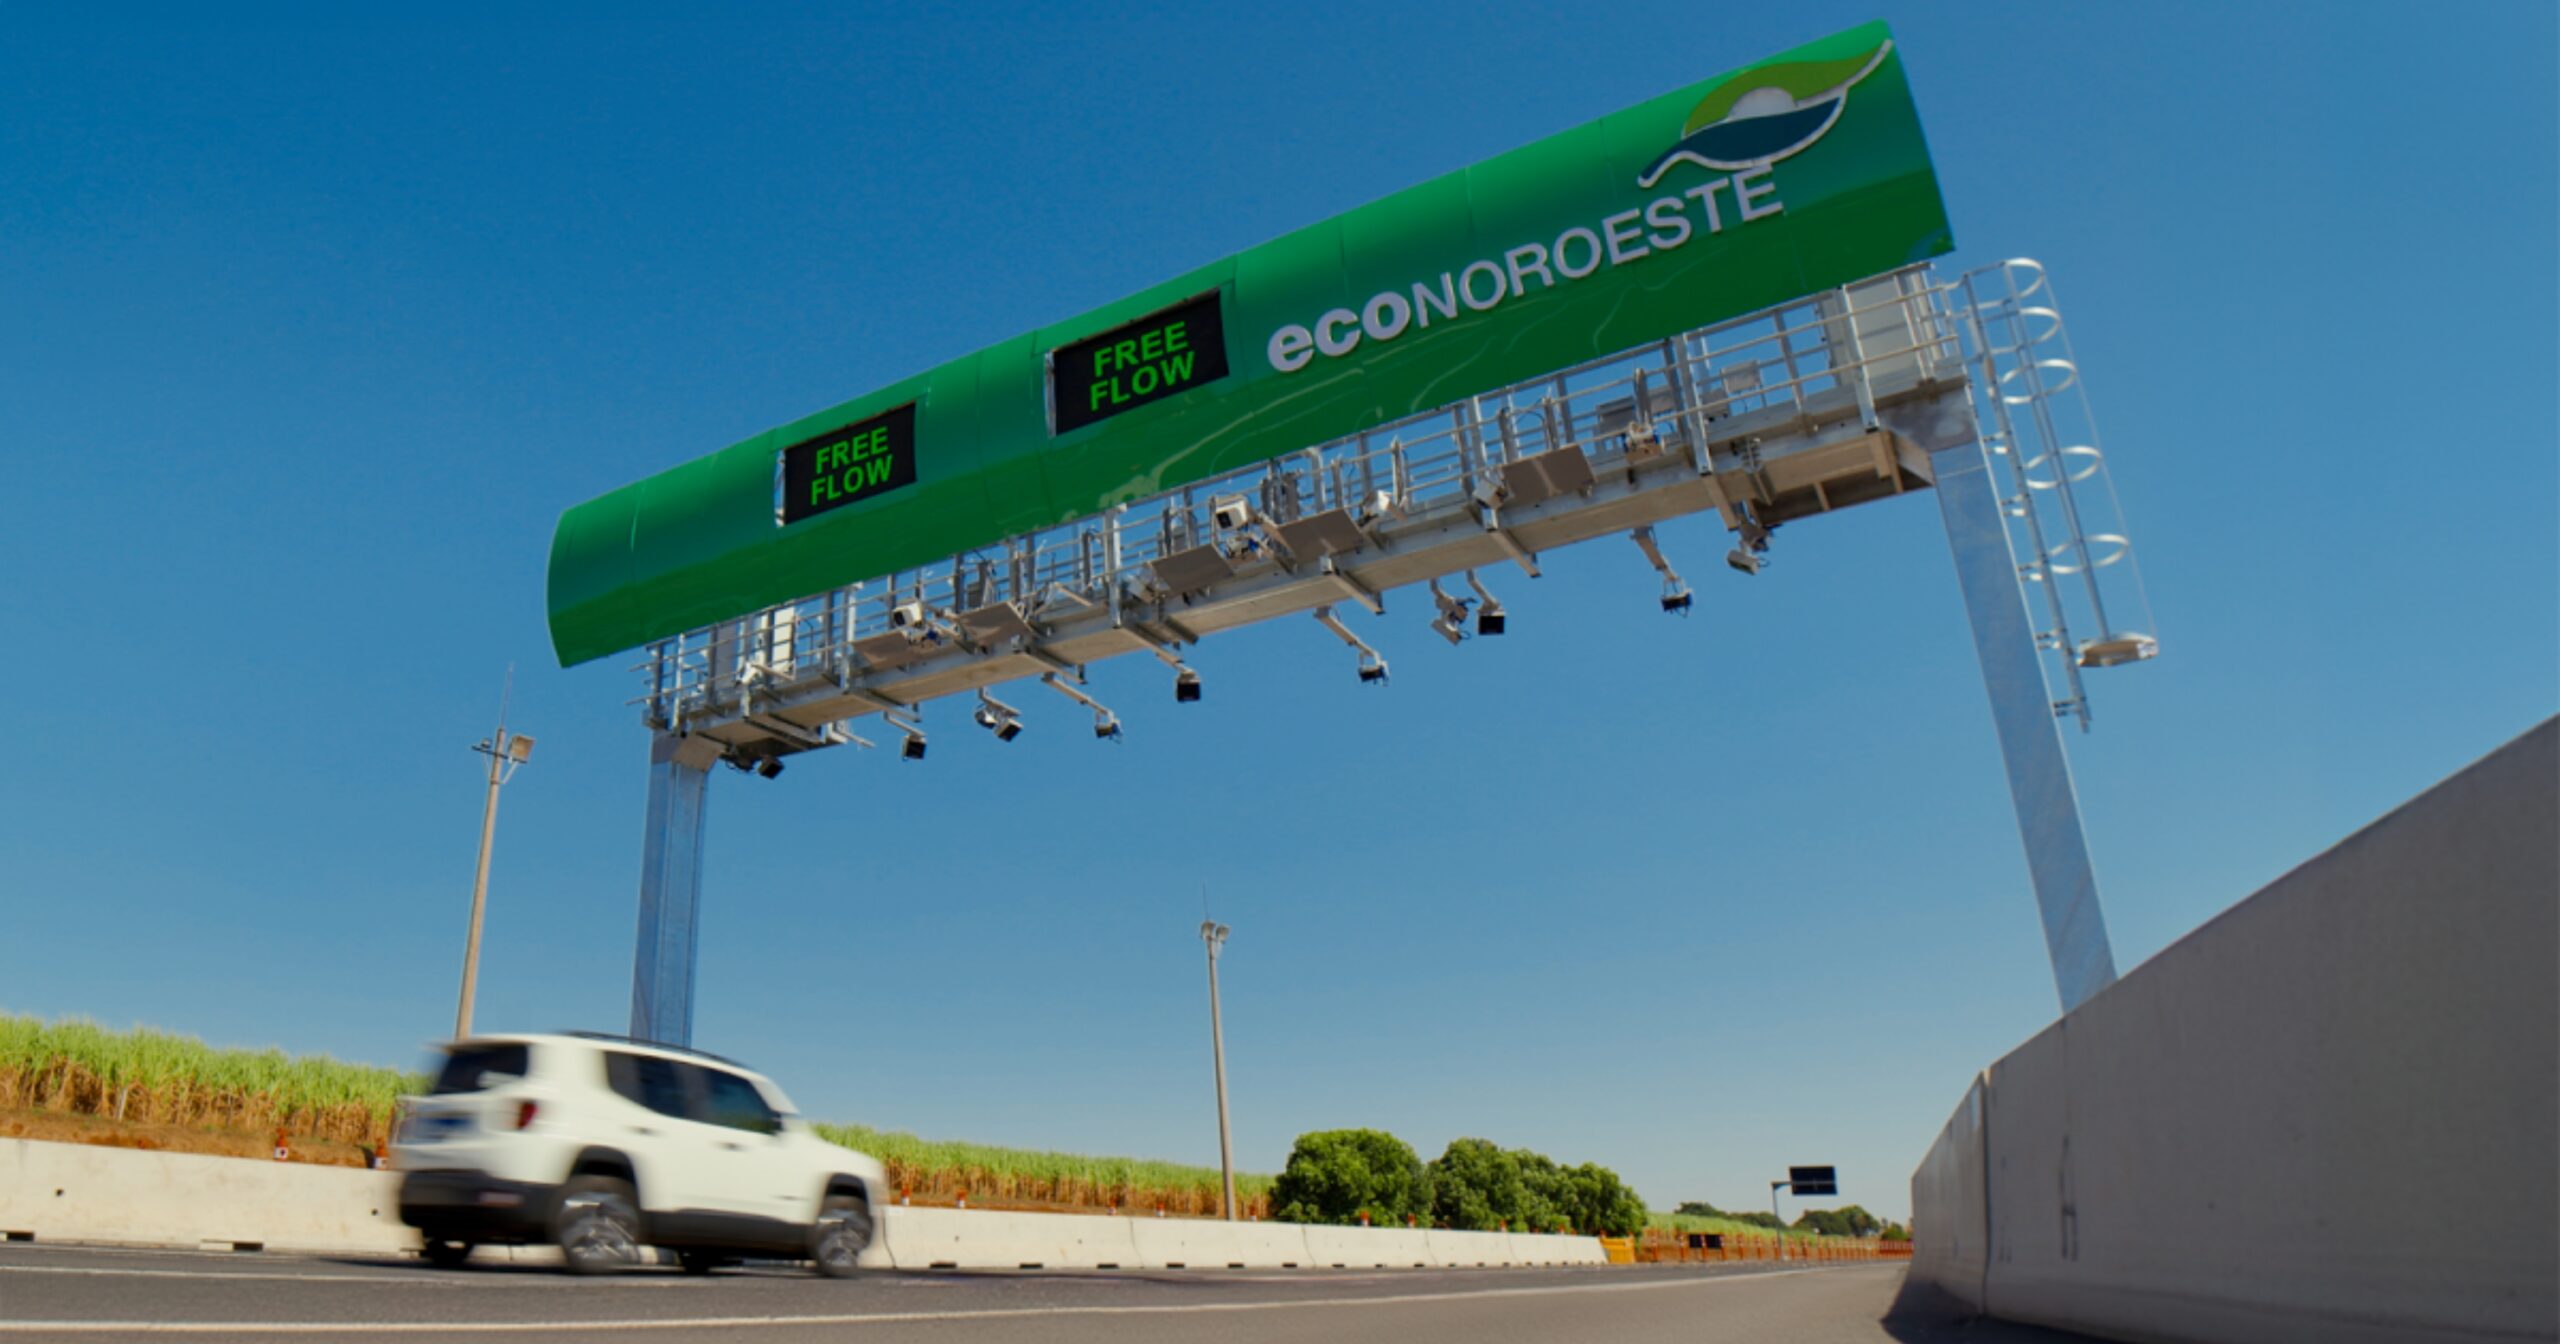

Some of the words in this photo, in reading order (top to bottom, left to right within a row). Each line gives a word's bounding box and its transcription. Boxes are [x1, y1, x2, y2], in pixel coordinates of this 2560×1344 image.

[1268, 161, 1783, 373] ecoNOROESTE
[1094, 321, 1189, 377] FREE
[1090, 351, 1195, 411] FLOW
[815, 427, 889, 474] FREE
[811, 455, 893, 506] FLOW
